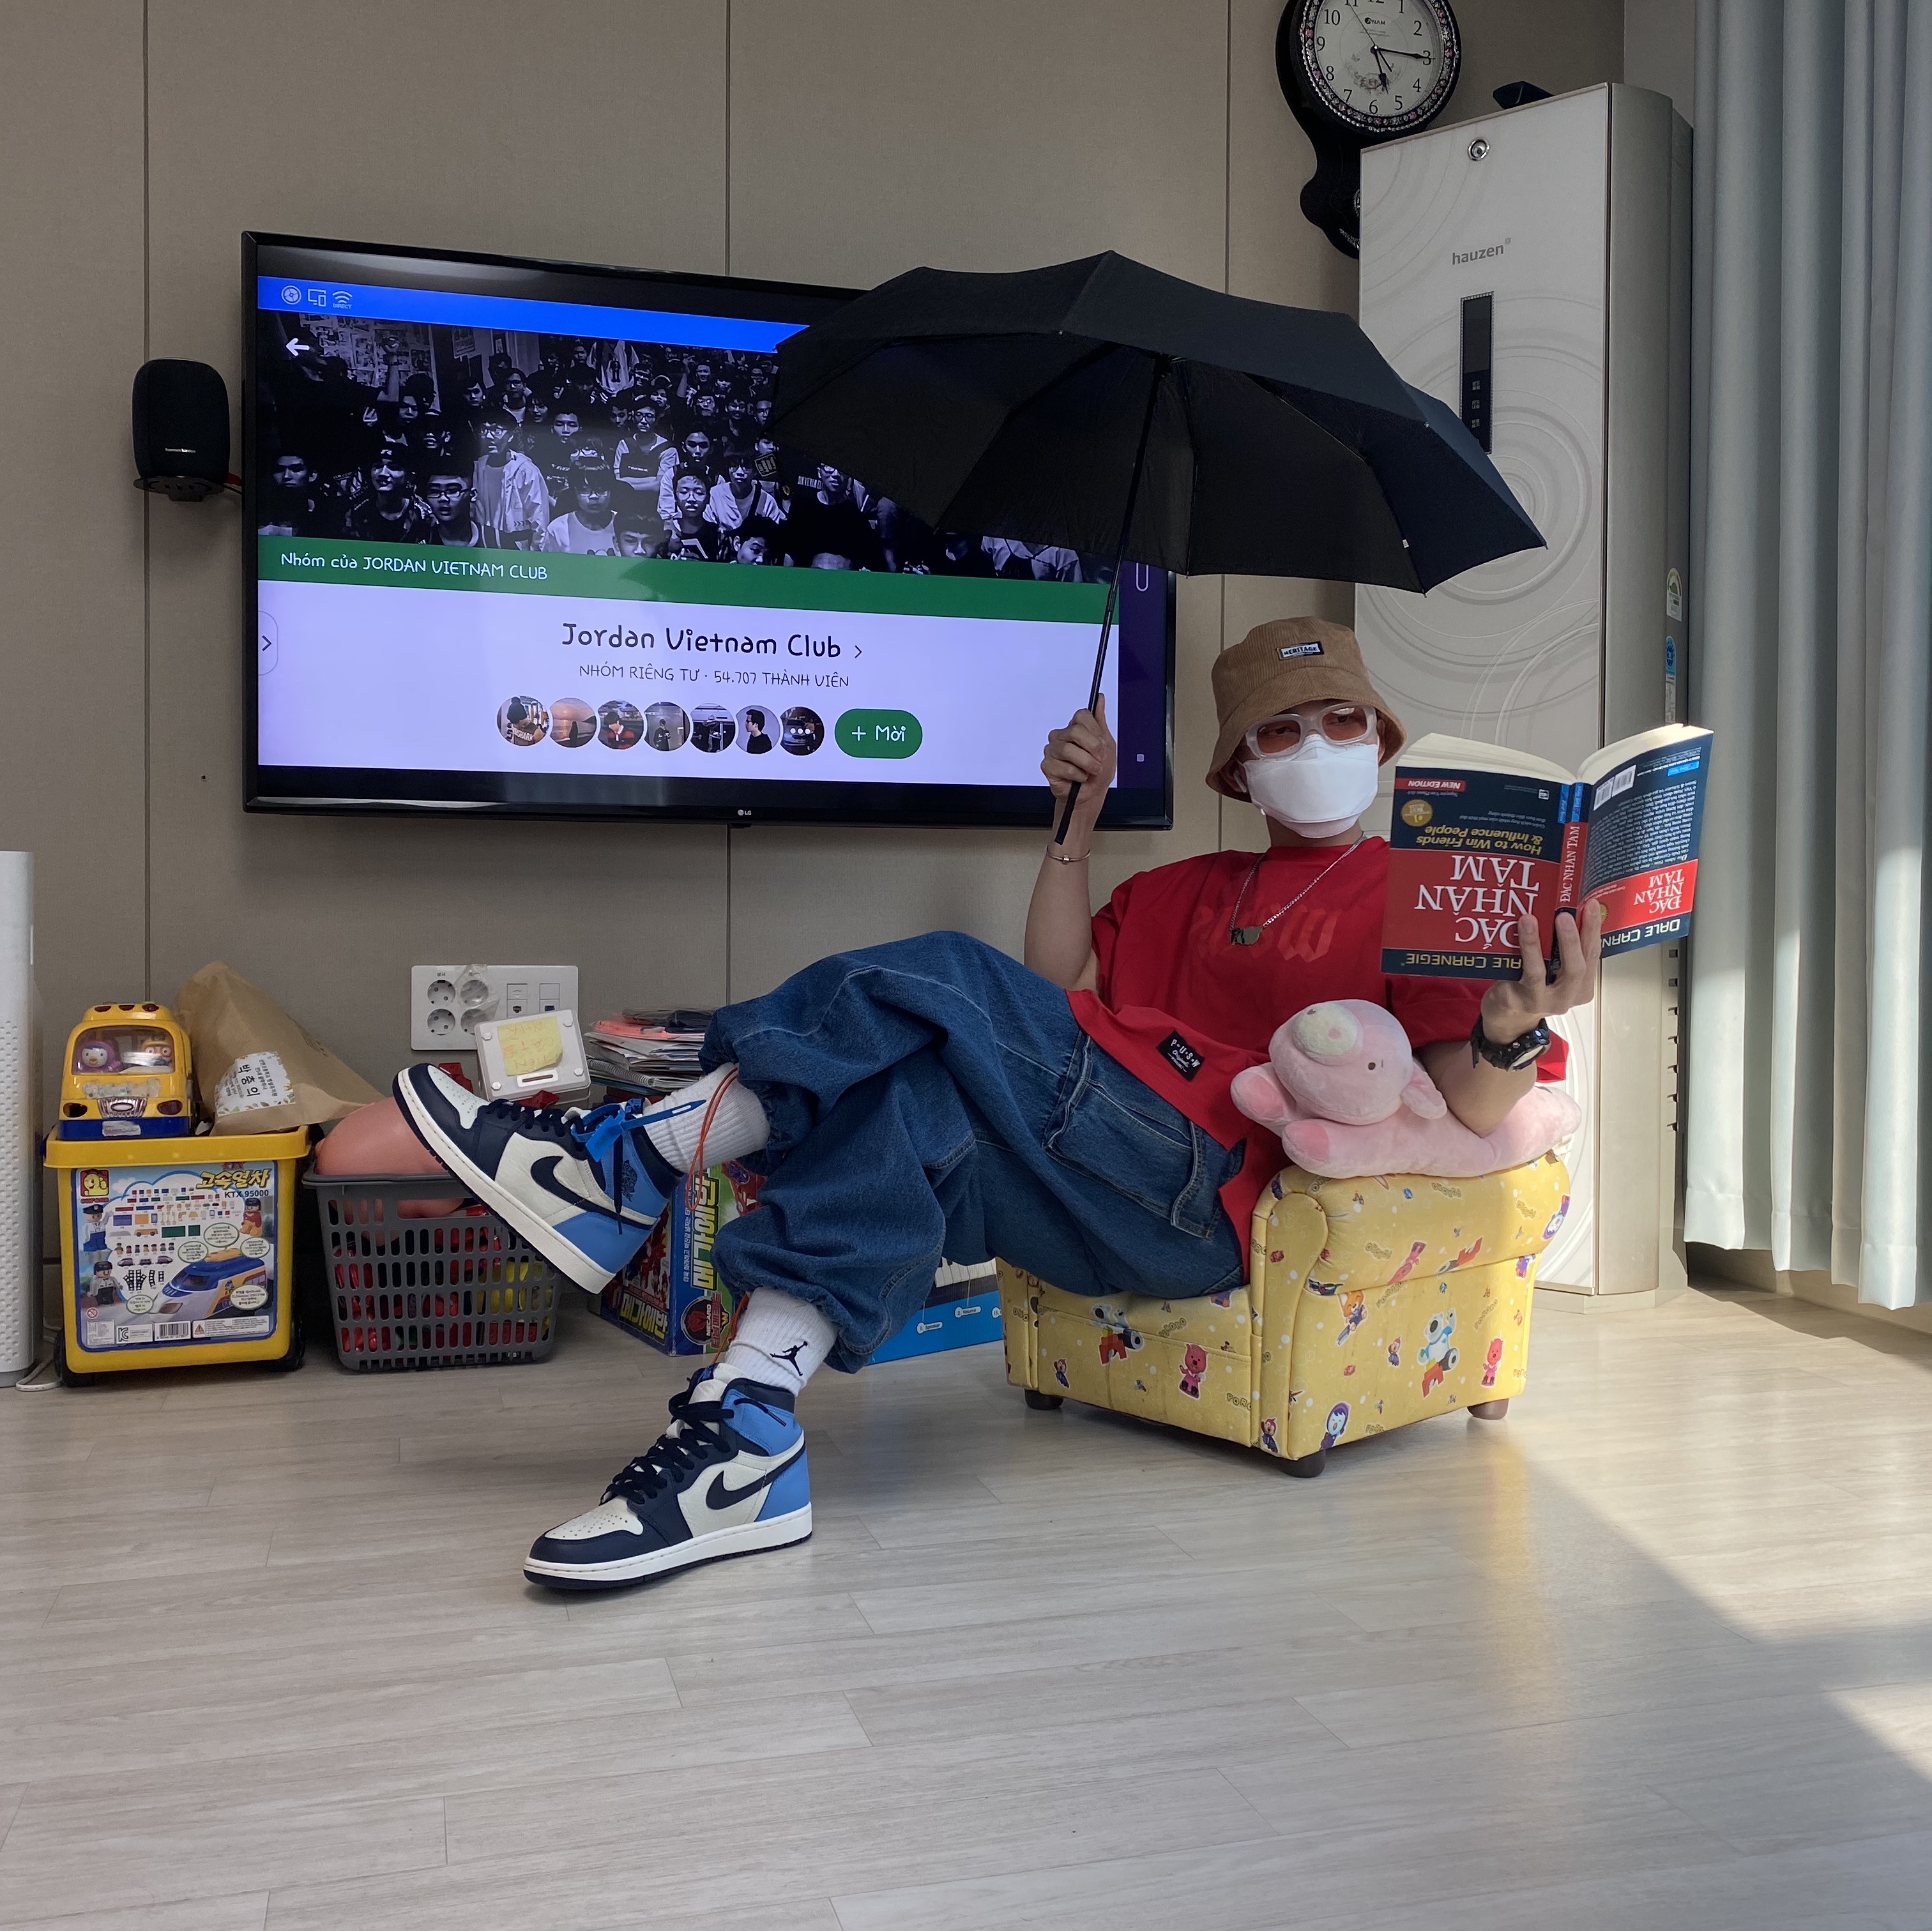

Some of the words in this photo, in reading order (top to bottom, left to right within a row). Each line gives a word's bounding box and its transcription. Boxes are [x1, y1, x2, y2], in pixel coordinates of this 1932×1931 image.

[1324, 10, 1340, 25] 10
[1413, 20, 1422, 36] 2
[1316, 36, 1325, 51] 9
[1422, 50, 1432, 65] 3
[1325, 66, 1334, 81] 8
[1413, 78, 1422, 93] 4
[1343, 89, 1353, 103] 7
[1394, 95, 1403, 110] 5
[1369, 100, 1378, 114] 6
[1452, 243, 1504, 264] hauzen
[281, 552, 325, 567] Nhóm
[331, 554, 358, 569] của
[363, 556, 427, 573] JORDAN
[430, 559, 505, 577] VIETNAM
[509, 564, 548, 580] CLUB
[561, 623, 655, 649] Jordan
[665, 626, 777, 656] Vietnam
[787, 634, 842, 659] Club
[1283, 646, 1317, 655] HERITAGE
[579, 662, 624, 679] NHÓM
[629, 664, 675, 681] RIÊNG
[680, 667, 700, 682] TƯ
[713, 670, 757, 685] 54.707
[761, 669, 811, 687] THÀNH
[815, 670, 850, 688] VIÊN
[875, 724, 906, 743] Mời
[1408, 780, 1440, 788] EDITION
[1441, 781, 1461, 789] NEW
[1424, 824, 1469, 837] People
[1471, 828, 1530, 844] Influence
[1415, 835, 1463, 847] Friends
[1464, 838, 1491, 849] Win
[1495, 840, 1509, 850] to
[1532, 835, 1544, 845] &
[1511, 842, 1542, 855] How
[1449, 855, 1540, 891] TÂM
[1413, 884, 1539, 917] NHÂN
[1645, 919, 1680, 937] DALE
[1602, 929, 1641, 948] CARN
[1406, 953, 1487, 969] CARNEGIE
[1492, 957, 1522, 969] ALE
[196, 1169, 272, 1190] 고속열차
